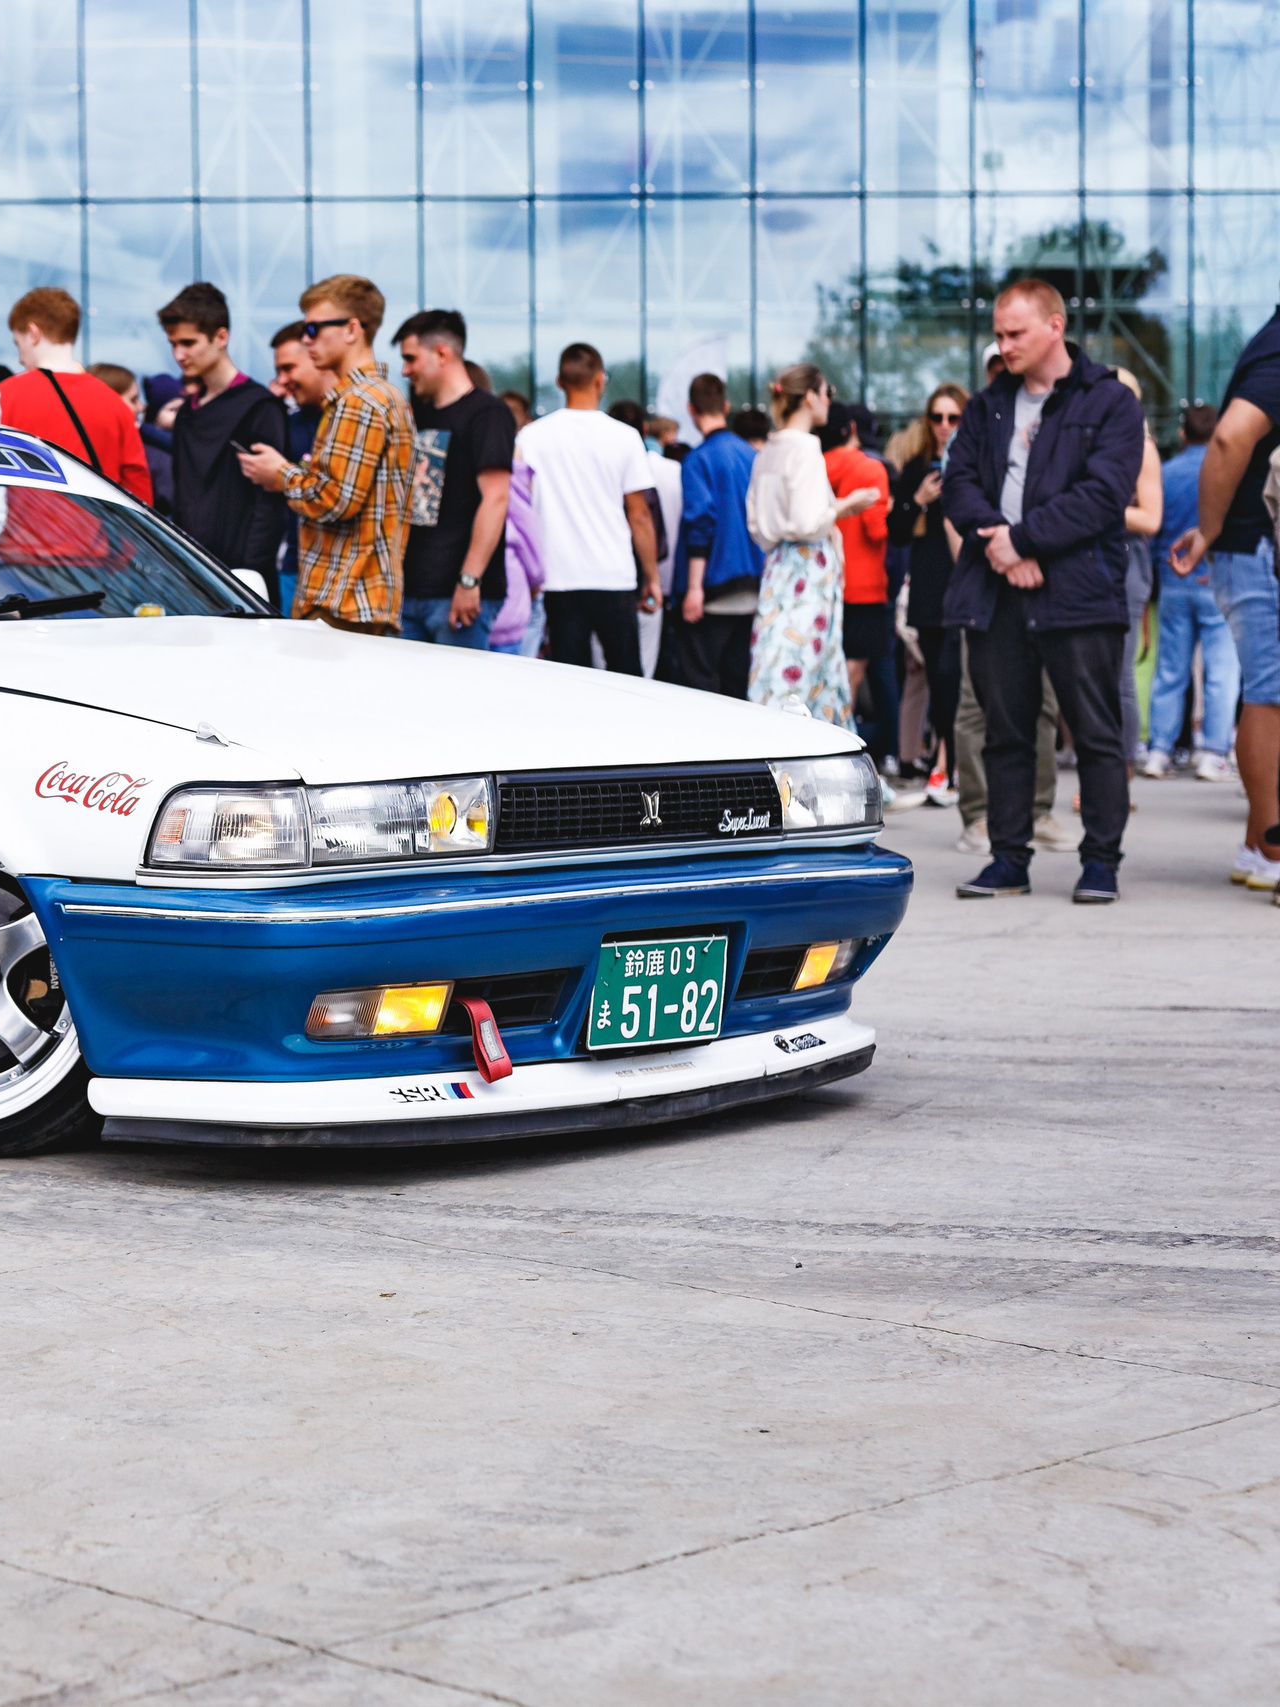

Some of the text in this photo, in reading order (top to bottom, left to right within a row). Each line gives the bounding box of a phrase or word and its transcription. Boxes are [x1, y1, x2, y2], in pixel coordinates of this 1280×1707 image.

[49, 953, 60, 990] SSAN
[624, 945, 696, 978] 鈴鹿 09
[597, 979, 719, 1039] ま 51-82
